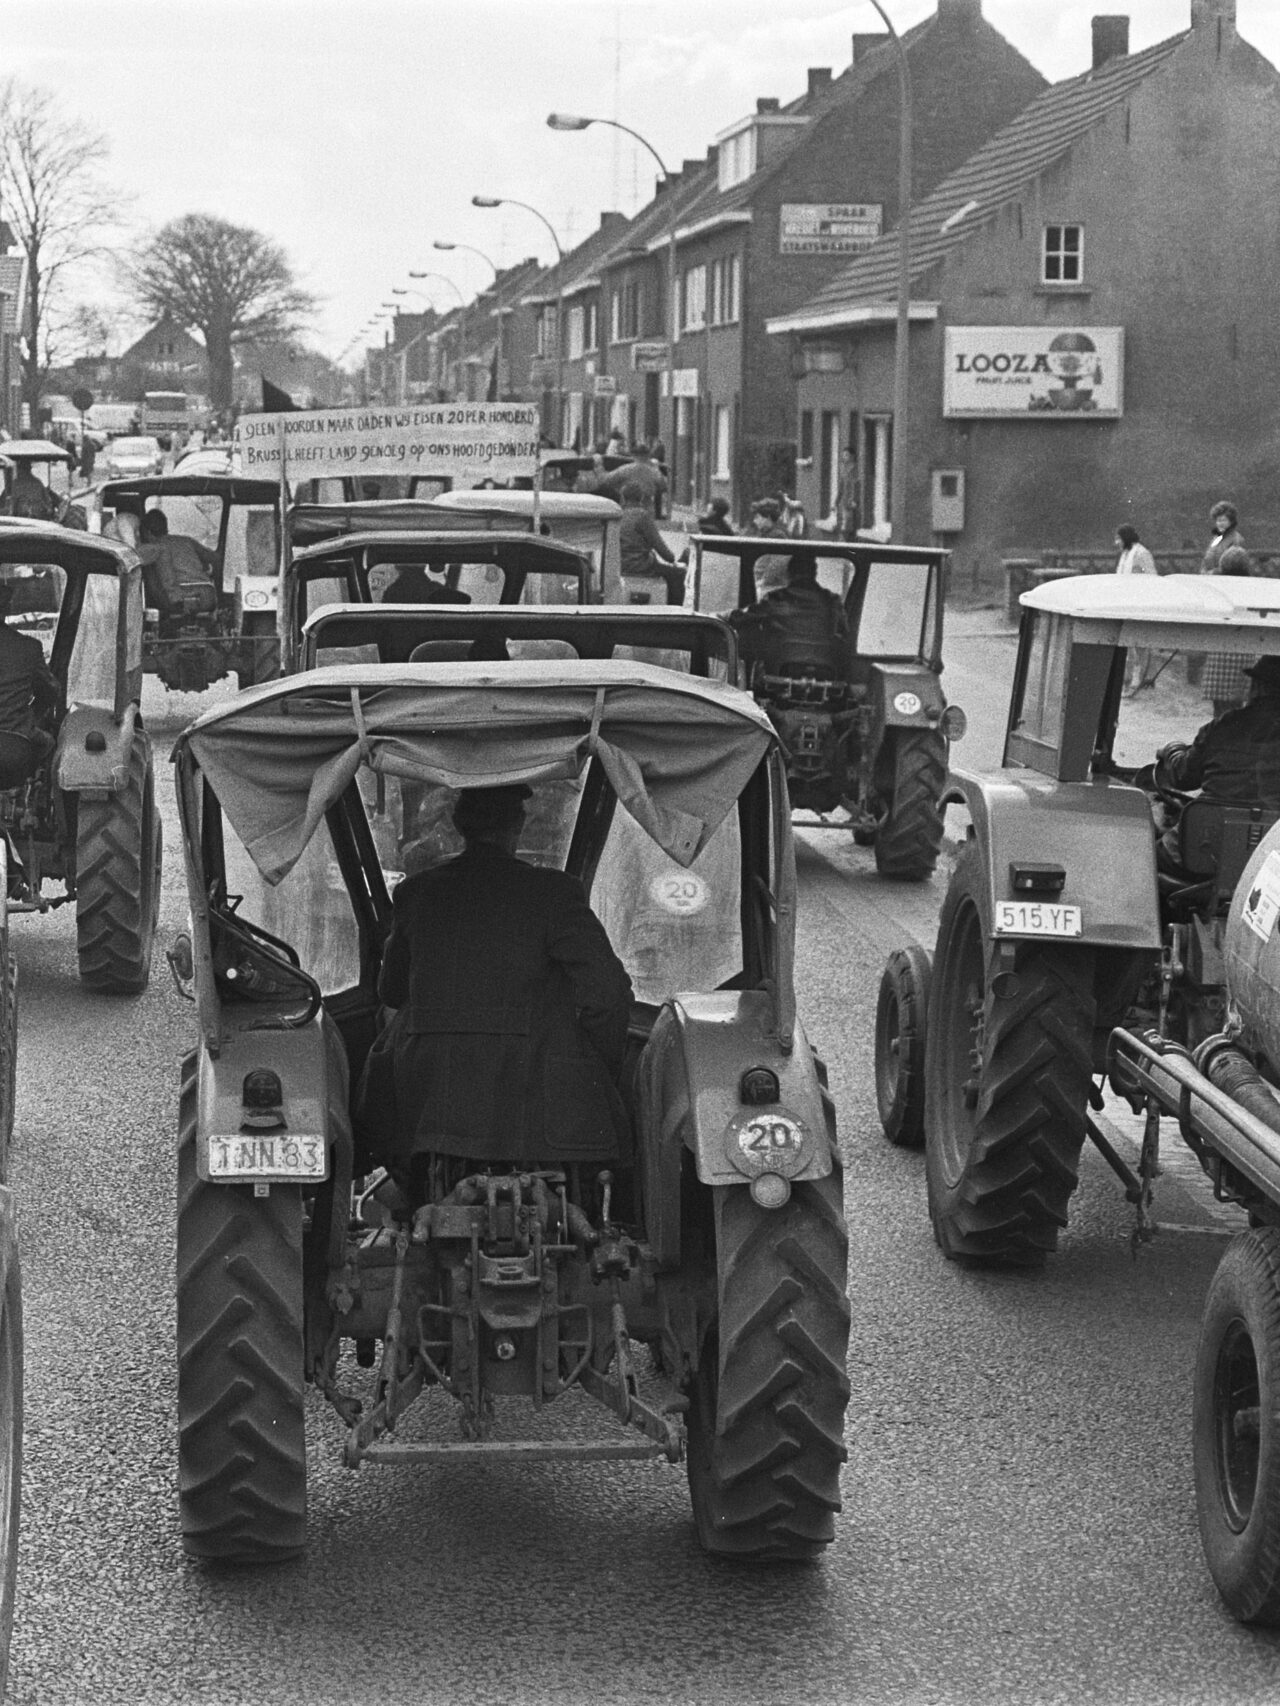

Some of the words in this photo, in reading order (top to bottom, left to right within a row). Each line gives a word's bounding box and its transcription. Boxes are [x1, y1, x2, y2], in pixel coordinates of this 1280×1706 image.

[956, 353, 1052, 373] LOOZA
[327, 418, 354, 433] MAAR
[357, 415, 392, 431] DADEN
[489, 408, 534, 425] HONDERD
[428, 443, 450, 456] ONS
[666, 882, 698, 898] 20
[748, 1123, 791, 1151] 20
